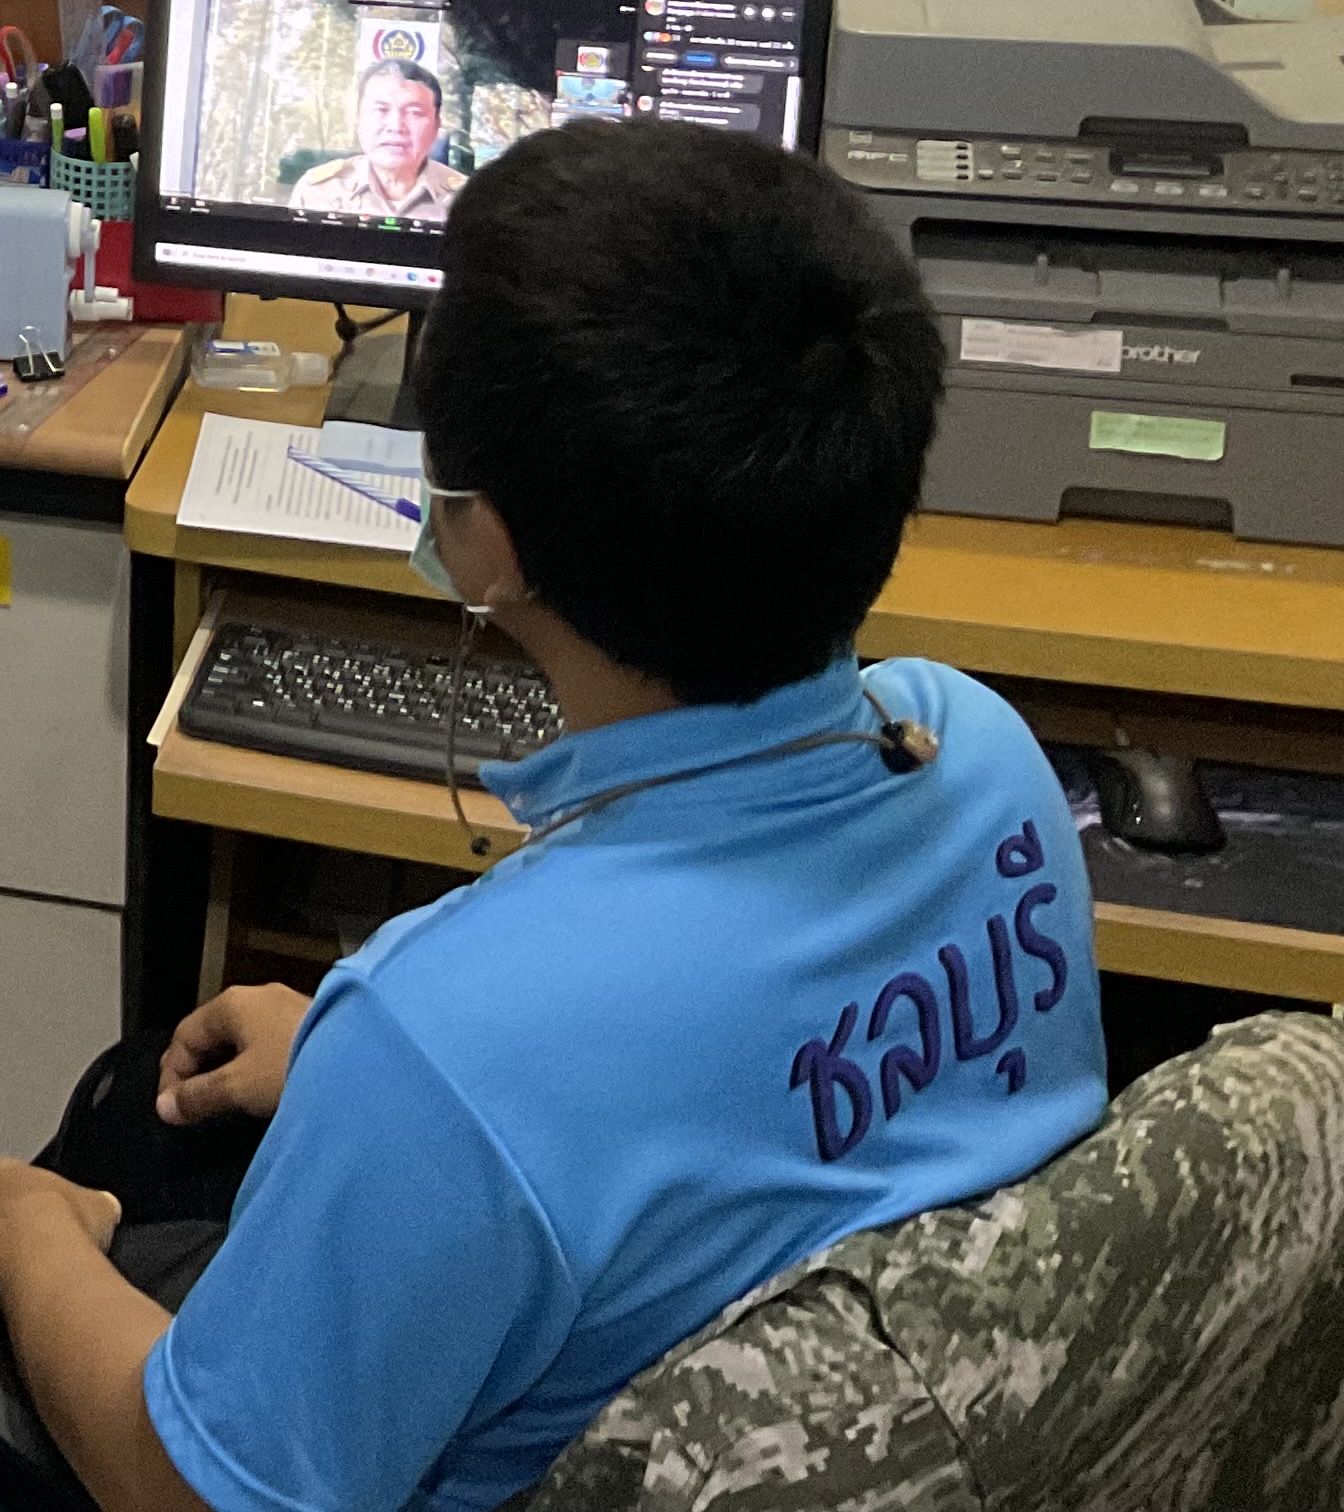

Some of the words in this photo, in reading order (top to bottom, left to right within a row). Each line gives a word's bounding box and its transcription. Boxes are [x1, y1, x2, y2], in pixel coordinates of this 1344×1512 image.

[846, 148, 909, 164] MFC
[788, 818, 1069, 1162] ชลบุรี
